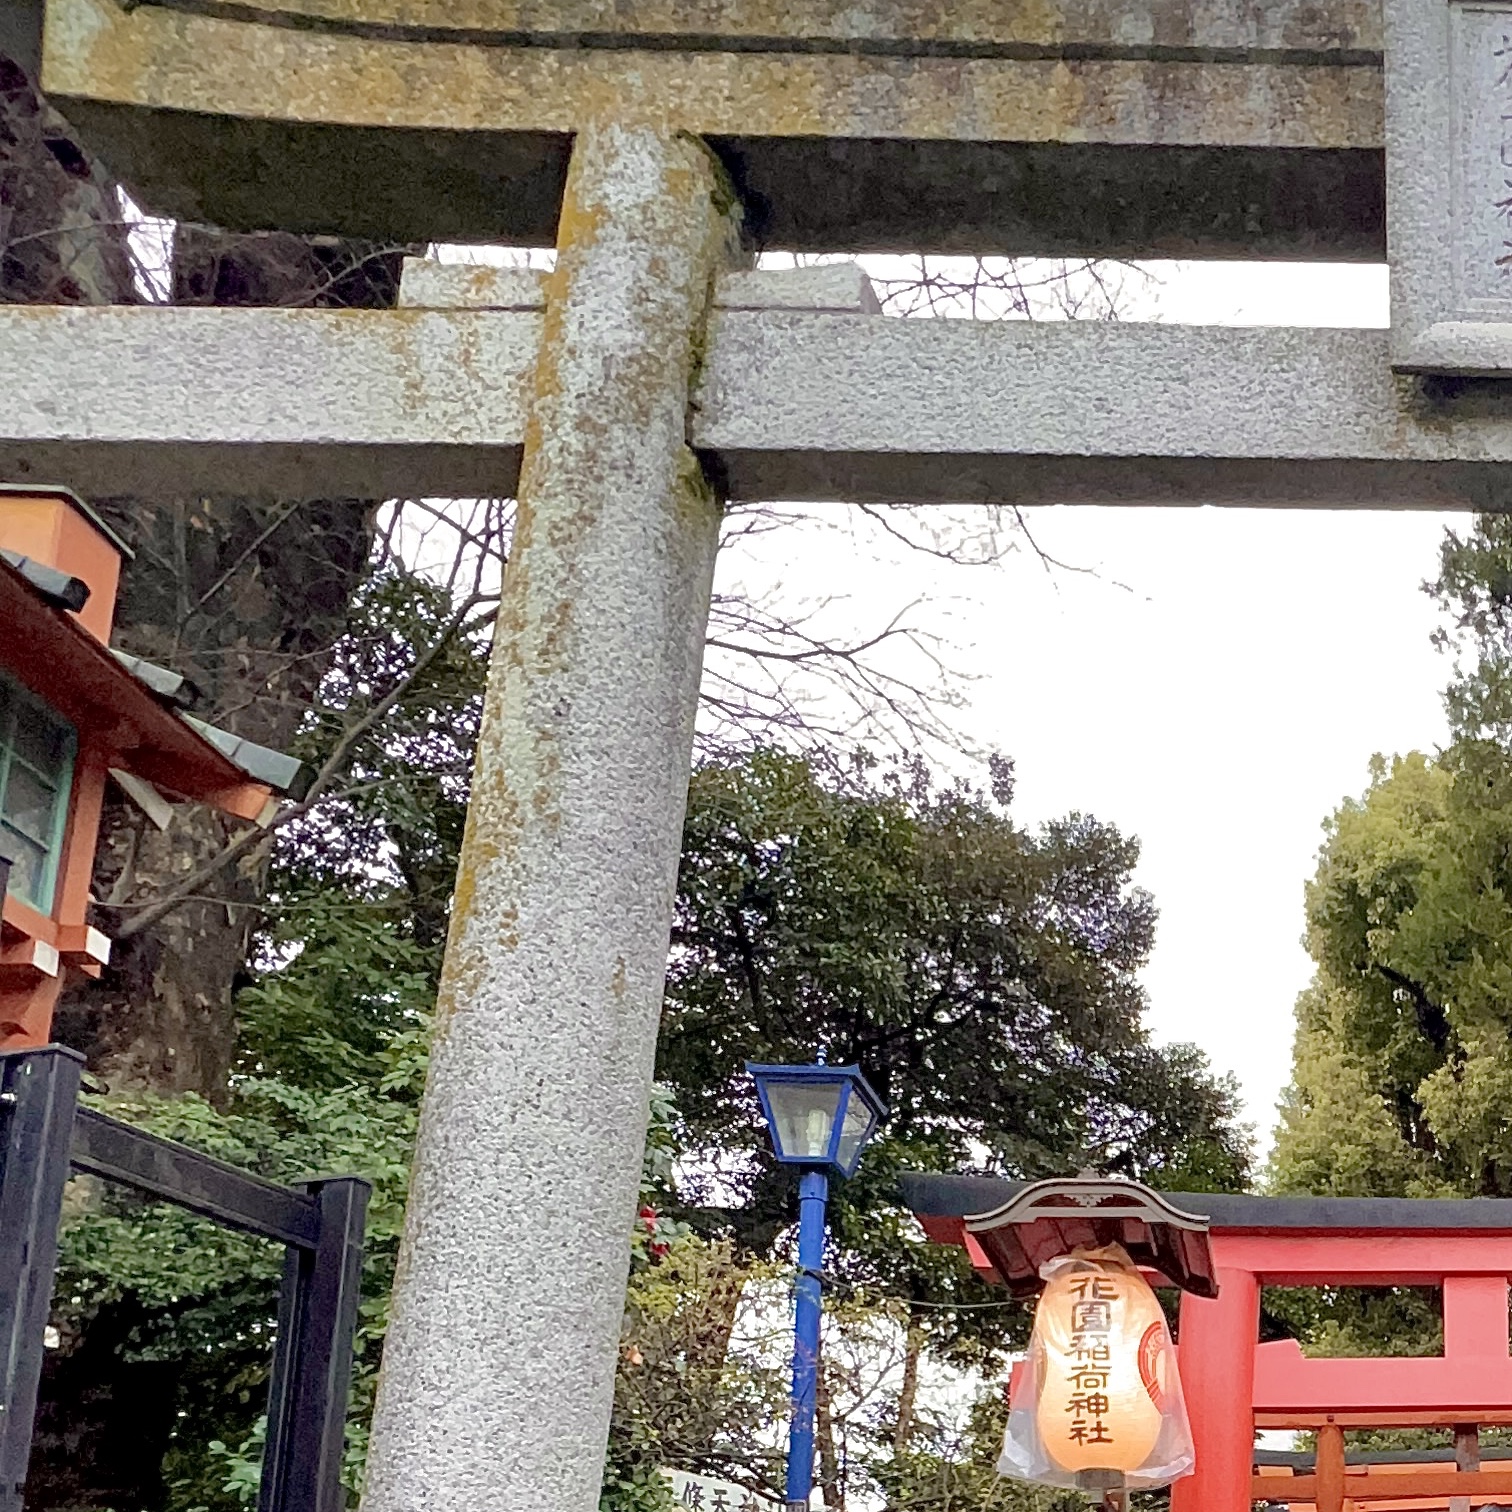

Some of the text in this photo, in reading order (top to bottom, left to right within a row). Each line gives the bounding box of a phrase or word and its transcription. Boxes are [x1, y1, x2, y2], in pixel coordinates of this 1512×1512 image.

[1064, 1275, 1121, 1447] 花園稲荷神社
